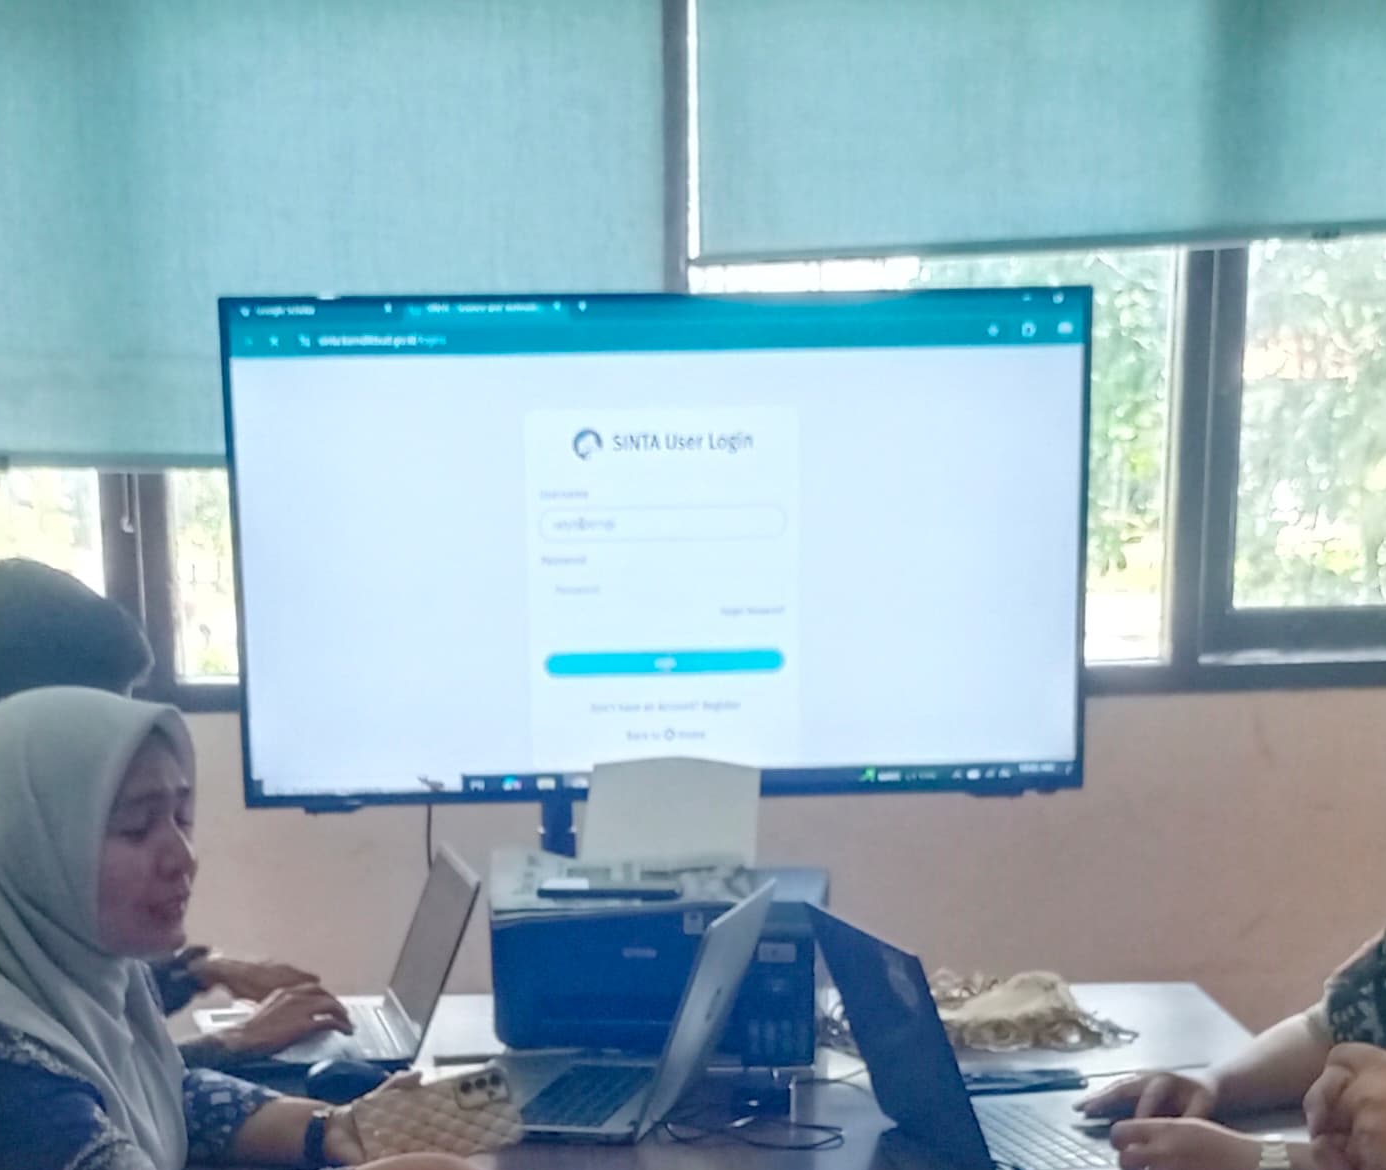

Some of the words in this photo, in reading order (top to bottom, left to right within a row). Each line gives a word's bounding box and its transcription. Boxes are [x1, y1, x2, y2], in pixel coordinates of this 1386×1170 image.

[613, 432, 661, 452] SINTA
[665, 432, 703, 451] User
[708, 429, 755, 455] Login
